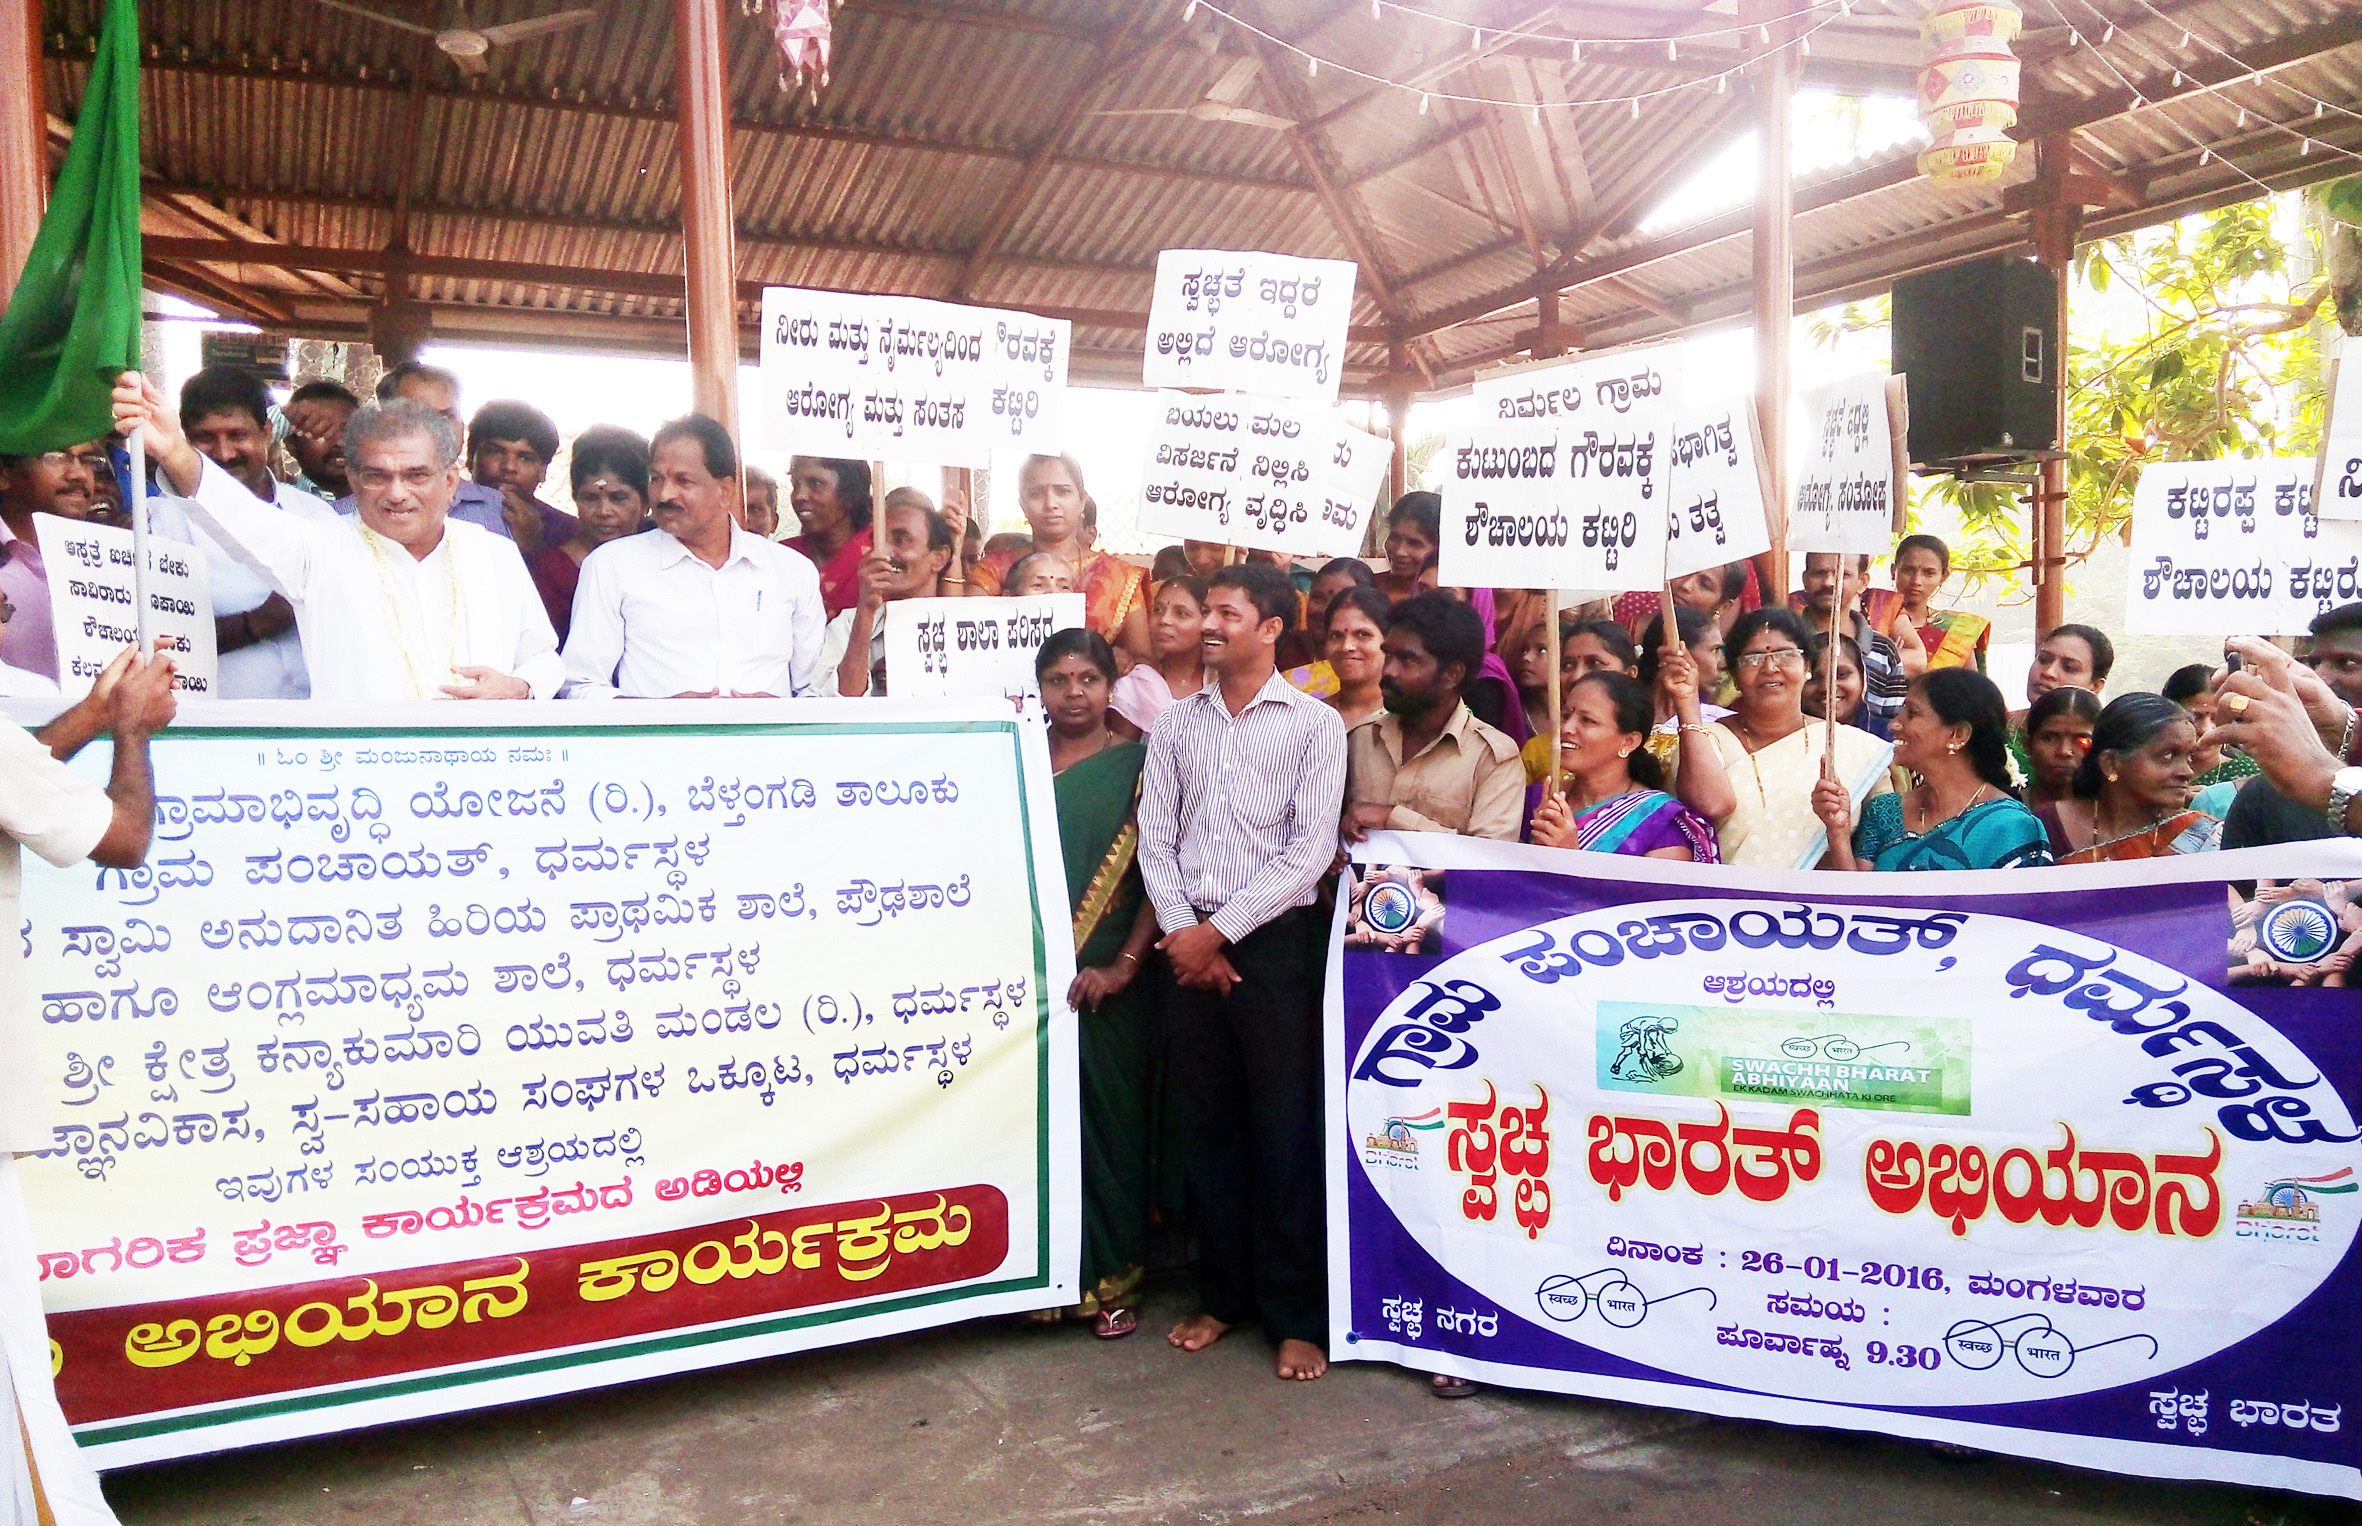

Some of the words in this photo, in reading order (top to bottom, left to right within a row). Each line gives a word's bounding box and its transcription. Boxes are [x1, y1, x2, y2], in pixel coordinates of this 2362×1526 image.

[1259, 274, 1321, 319] ಇದ್ದರೆ
[776, 312, 818, 347] ನೀರು
[829, 313, 869, 364] ಮತ್ತು
[880, 318, 982, 377] ನೈರ್ಮಲ್ಯದಿಂದ
[1157, 326, 1215, 366] ಅಲ್ಲಿದೆ
[1229, 331, 1330, 384] ಆರೋಗ್ಯ
[786, 381, 854, 438] ಆರೋಗ್ಯ
[864, 386, 903, 437] ಮತ್ತು
[913, 391, 966, 429] ಸಂತಸ
[1499, 387, 1581, 418] ನಿರ್ಮಲ
[1596, 364, 1662, 414] ಗ್ರಾಮ
[1166, 404, 1239, 432] ಬಯಲು
[1251, 412, 1301, 438] ಮಲ
[1156, 443, 1239, 473] ವಿಸರ್ಜನೆ
[1251, 455, 1309, 488] ನಿಲ್ಲಿಸಿ
[1456, 434, 1557, 479] ಕುಟುಂಬದ
[1570, 430, 1654, 499] ಗೌರವಕ್ಕೆ
[1145, 481, 1231, 525] ಆರೋಗ್ಯ
[1465, 501, 1567, 547] ಶೌಚಾಲಯ
[1582, 503, 1636, 571] ಕಟ್ಟಿರಿ
[2143, 556, 2272, 599] ಶೌಚಾಲಯ
[957, 619, 999, 651] ಶಾಲಾ
[318, 749, 343, 771] ಶ್ರೀ
[355, 747, 497, 766] ಮಂಜುನಾಥಾಯ
[410, 778, 564, 818] ಯೋಜನೆ
[688, 775, 817, 827] ಬೆಳ್ತಂಗಡಿ
[836, 772, 959, 807] ತಾಲೂಕು
[246, 842, 509, 888] ಪಂಚಾಯತ್,
[534, 833, 711, 890] ಧರ್ಮಸ್ಥಳ
[61, 918, 171, 978] ಸ್ವಾಮಿ
[200, 903, 402, 950] ಅನುದಾನಿತ
[428, 898, 547, 938] ಹಿರಿಯ
[570, 889, 716, 943] ಪ್ರಾಥಮಿಕ
[737, 882, 817, 920] ಶಾಲೆ,
[836, 873, 971, 926] ಪ್ರೌಢಶಾಲೆ
[41, 978, 179, 1024] ಹಾಗೂ
[207, 960, 469, 1026] ಆಂಗ್ಲಮಾಧ್ಯಮ
[493, 951, 585, 995] ಶಾಲೆ,
[606, 941, 760, 996] ಧರ್ಮಸ್ಥಳ
[1703, 970, 1836, 1009] ಆಶ್ರಯದಲ್ಲಿ
[60, 1049, 115, 1106] ಶ್ರೀ
[144, 1039, 236, 1102] ಕ್ಷೇತ್ರ
[256, 1022, 482, 1091] ಕನ್ಯಾಕುಮಾರಿ
[505, 1009, 634, 1052] ಯುವತಿ
[655, 996, 782, 1040] ಮಂಡಲ
[891, 975, 1027, 1030] ಧರ್ಮಸ್ಥಳ
[1353, 980, 1502, 1088] ಗ್ರಾಮ
[2005, 944, 2362, 1144] ಧರ್ಮಸ್ಥಳ
[521, 1062, 665, 1112] ಸಂಘಗಳ
[833, 1032, 972, 1088] ಧರ್ಮಸ್ಥಳ
[1731, 1059, 1831, 1078] SWACHH
[1836, 1065, 1931, 1084] BHARAT
[1731, 1072, 1850, 1091] ABHIYAAN
[1733, 1085, 1747, 1093] EK
[1748, 1086, 1788, 1096] KADAM
[1790, 1089, 1859, 1100] SWACHHATA
[1874, 1094, 1896, 1103] ORE
[215, 1160, 333, 1202] ಇವುಗಳ
[355, 1145, 482, 1187] ಸಂಯುಕ್ತ
[497, 1127, 645, 1177] ಆಶ್ರಯದಲ್ಲಿ
[1447, 1078, 1552, 1240] ಸ್ವಚ್ಛ
[1588, 1100, 1821, 1203] ಭಾರತ್
[1865, 1121, 2222, 1237] ಅಭಿಯಾನ
[233, 1217, 349, 1267] ಪ್ರಜ್ಞಾ
[362, 1175, 632, 1239] ಕಾರ್ಯಕ್ರಮದ
[654, 1159, 804, 1201] ಅಡಿಯಲ್ಲಿ
[125, 1257, 530, 1367] ಅಭಿಯಾನ
[578, 1193, 972, 1303] ಕಾರ್ಯಕ್ರಮ
[1606, 1235, 1704, 1267] ದಿನಾಂಕ
[1741, 1250, 1951, 1294] 26-01-2016,
[1968, 1270, 2147, 1312] ಮಂಗಳವಾರ
[1436, 1303, 1499, 1338] ನಗರ
[1546, 1291, 1578, 1307] स्वच्छ
[1606, 1297, 1637, 1313] भारत
[1767, 1289, 1866, 1323] ಸಮಯ
[1866, 1340, 1941, 1371] 9.30
[1957, 1338, 1993, 1354] स्वच्छ
[2028, 1346, 2061, 1362] भारत
[2230, 1397, 2341, 1434] ಭಾರತ
